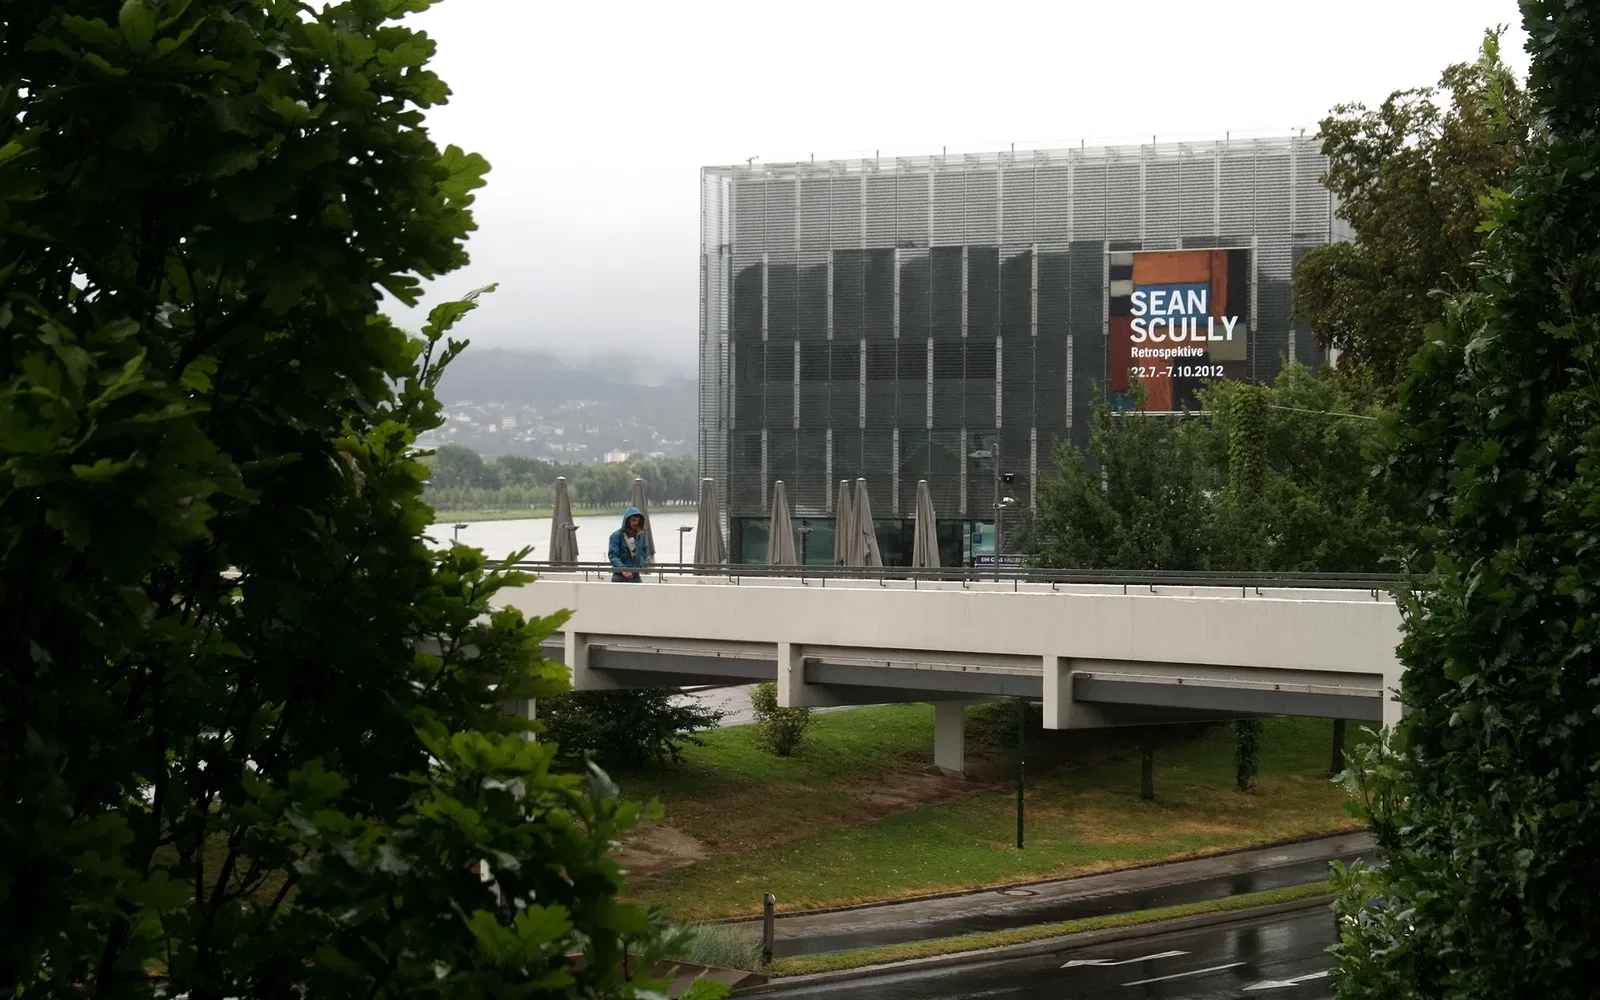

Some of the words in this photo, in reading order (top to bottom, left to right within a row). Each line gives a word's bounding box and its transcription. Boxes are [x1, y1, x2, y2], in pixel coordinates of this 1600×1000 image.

[1130, 289, 1207, 316] SEAN
[1130, 315, 1239, 343] SCULLY
[1131, 346, 1204, 360] Retrospektive
